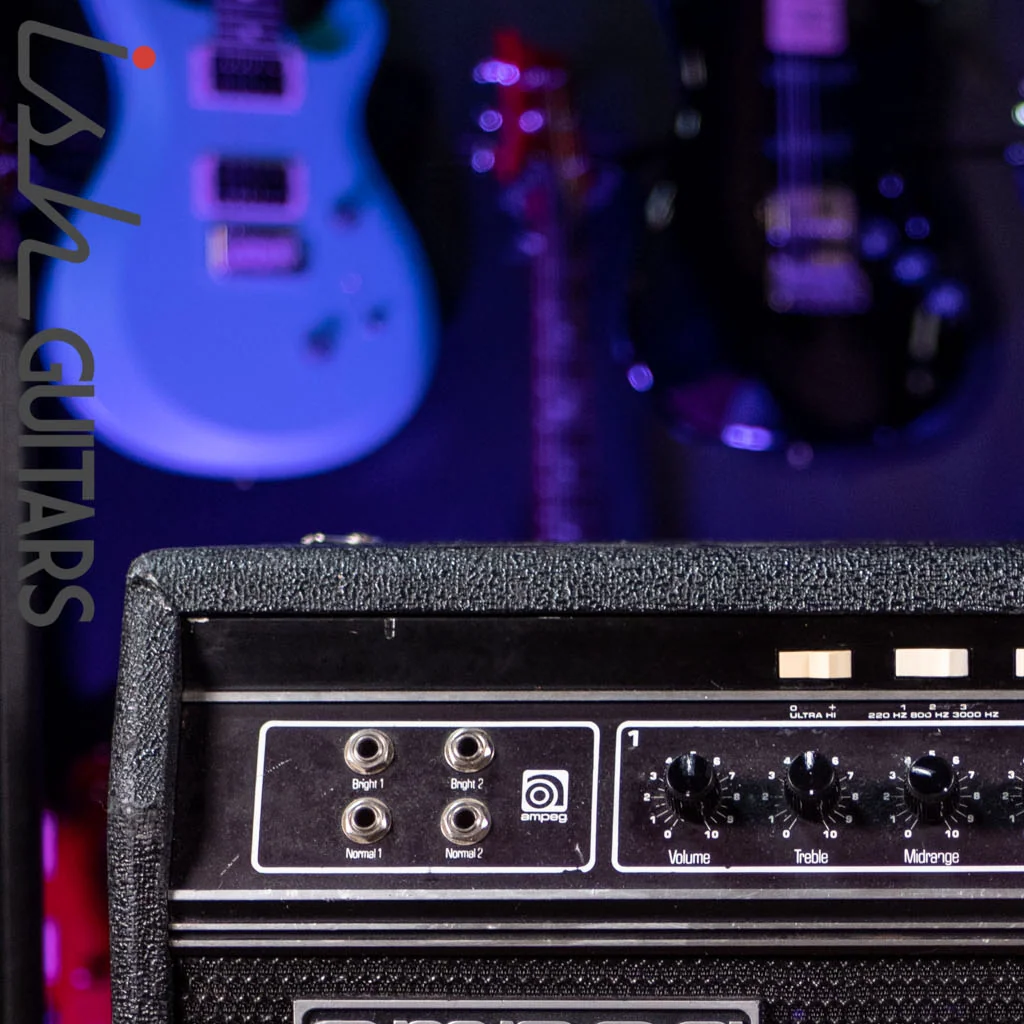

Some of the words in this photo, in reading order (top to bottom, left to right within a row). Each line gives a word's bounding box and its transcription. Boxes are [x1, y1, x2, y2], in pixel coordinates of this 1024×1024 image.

[900, 703, 906, 711] 1
[928, 703, 937, 711] 2
[959, 703, 968, 711] 3
[867, 711, 891, 719] 220
[892, 711, 908, 719] HZ
[910, 711, 933, 719] 800
[934, 711, 950, 719] HZ
[952, 711, 982, 719] 3000
[627, 729, 640, 748] 1
[713, 756, 721, 766] 6
[831, 756, 840, 766] 6
[952, 755, 960, 765] 6
[649, 771, 658, 781] 3
[728, 771, 736, 780] 7
[768, 770, 776, 780] 3
[847, 771, 854, 780] 7
[888, 770, 897, 780] 3
[967, 770, 975, 779] 7
[1007, 770, 1015, 779] 3
[351, 777, 378, 792] Bright
[379, 777, 384, 789] 1
[450, 777, 476, 792] Bright
[477, 777, 484, 790] 2
[643, 792, 651, 802] 2
[733, 792, 741, 801] 8
[761, 792, 769, 801] 2
[852, 792, 859, 801] 8
[883, 792, 890, 801] 2
[973, 791, 981, 800] 8
[1002, 791, 1009, 800] 2
[520, 812, 568, 824] ampeg
[649, 815, 656, 825] 1
[726, 815, 734, 824] 9
[768, 815, 775, 824] 1
[845, 815, 853, 824] 9
[889, 814, 896, 824] 1
[967, 814, 974, 823] 9
[1009, 814, 1015, 823] 1
[663, 829, 672, 839] 0
[704, 830, 719, 839] 10
[782, 829, 791, 839] 0
[822, 829, 838, 839] 10
[904, 829, 913, 839] 0
[944, 829, 960, 839] 10
[345, 847, 377, 860] Normal
[377, 847, 382, 859] 1
[445, 847, 477, 860] Normal
[476, 846, 484, 859] 2
[668, 849, 711, 865] Volume
[793, 848, 829, 865] Treble
[903, 848, 960, 866] Midrange
